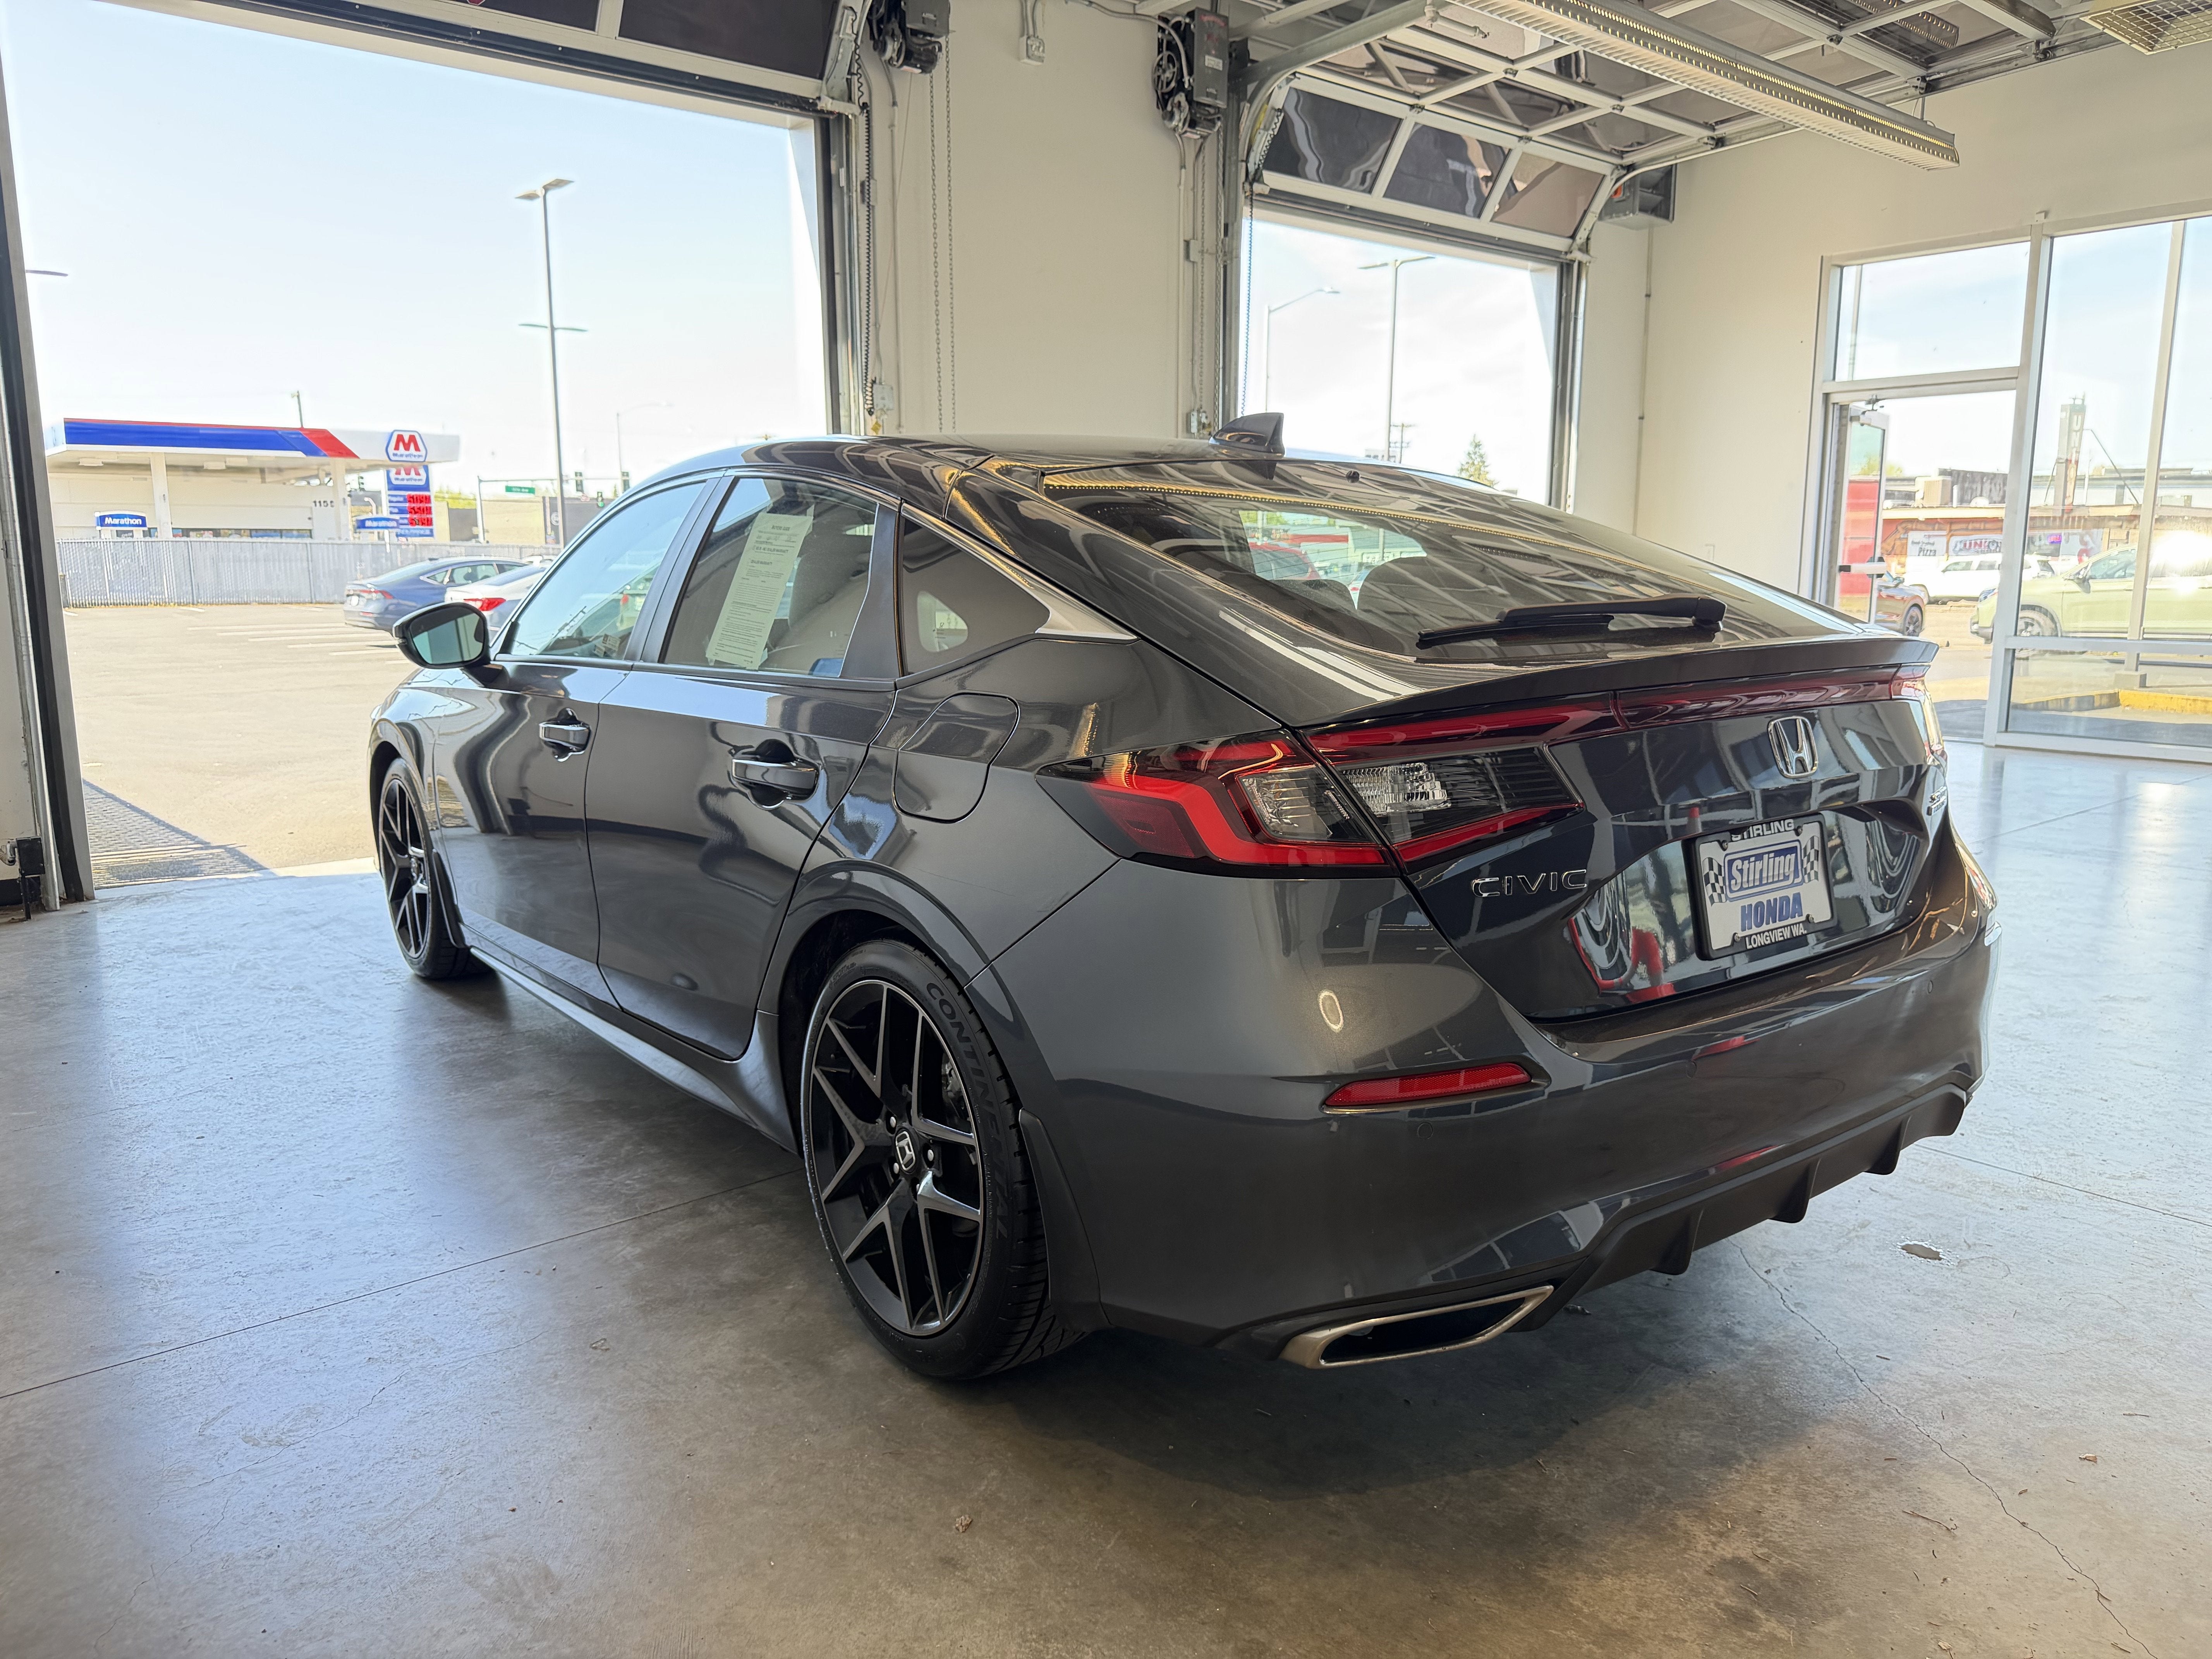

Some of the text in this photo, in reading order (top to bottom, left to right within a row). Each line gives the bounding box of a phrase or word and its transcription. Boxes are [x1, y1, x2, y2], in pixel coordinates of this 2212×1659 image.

[1472, 869, 1587, 897] CIVIC
[1730, 852, 1796, 891] Stirling
[1740, 892, 1803, 932] HONDA
[1745, 927, 1792, 949] LONGVIEW
